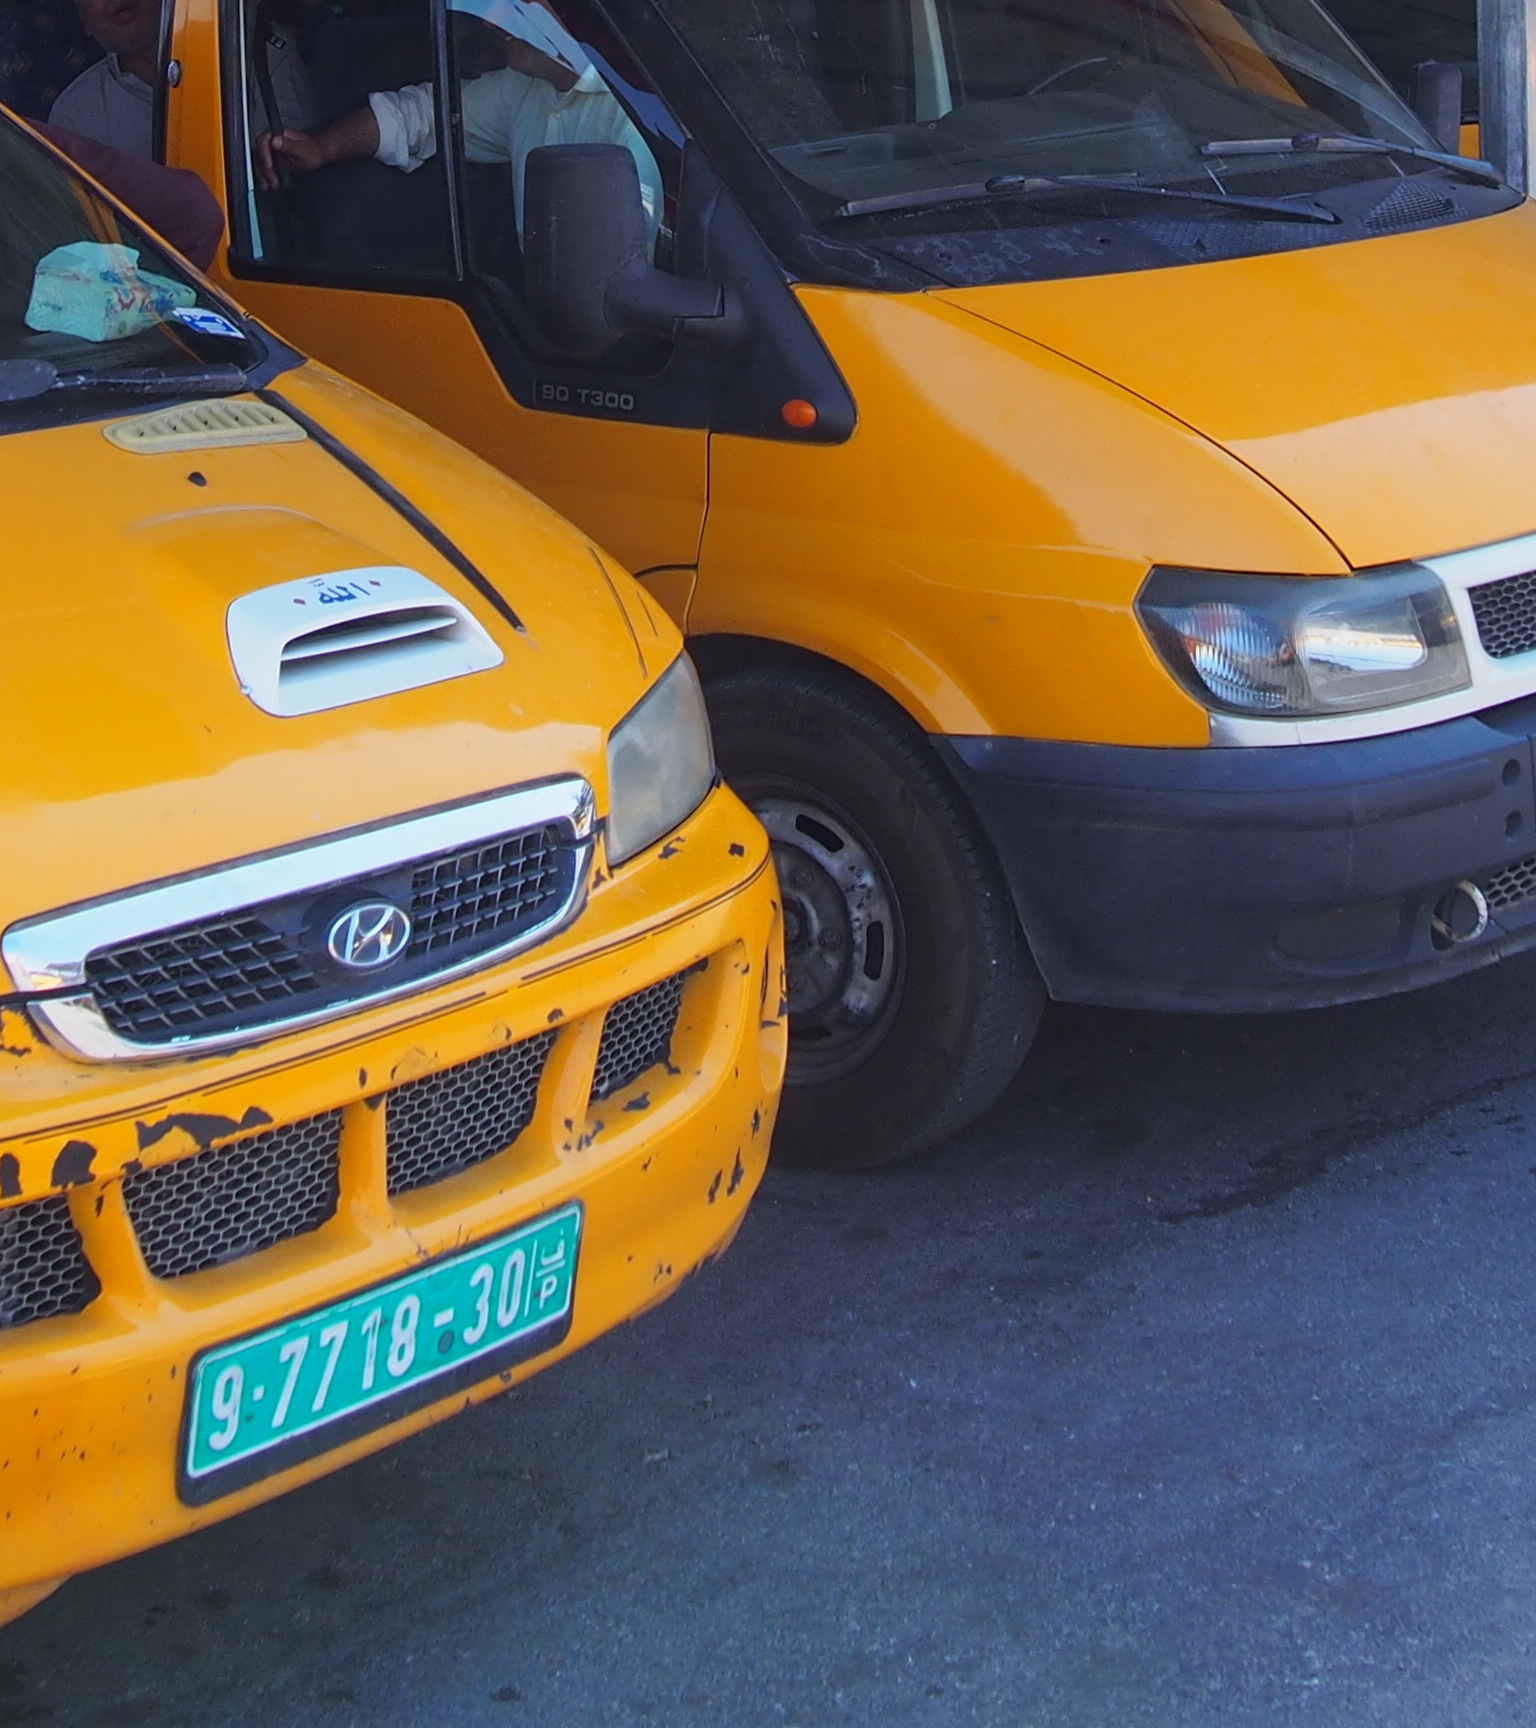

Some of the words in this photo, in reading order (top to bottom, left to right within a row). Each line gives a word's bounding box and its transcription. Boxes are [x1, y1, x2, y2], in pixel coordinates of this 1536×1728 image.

[542, 383, 570, 402] 90
[576, 387, 634, 411] T300
[317, 580, 371, 605] الله
[539, 1274, 558, 1310] P
